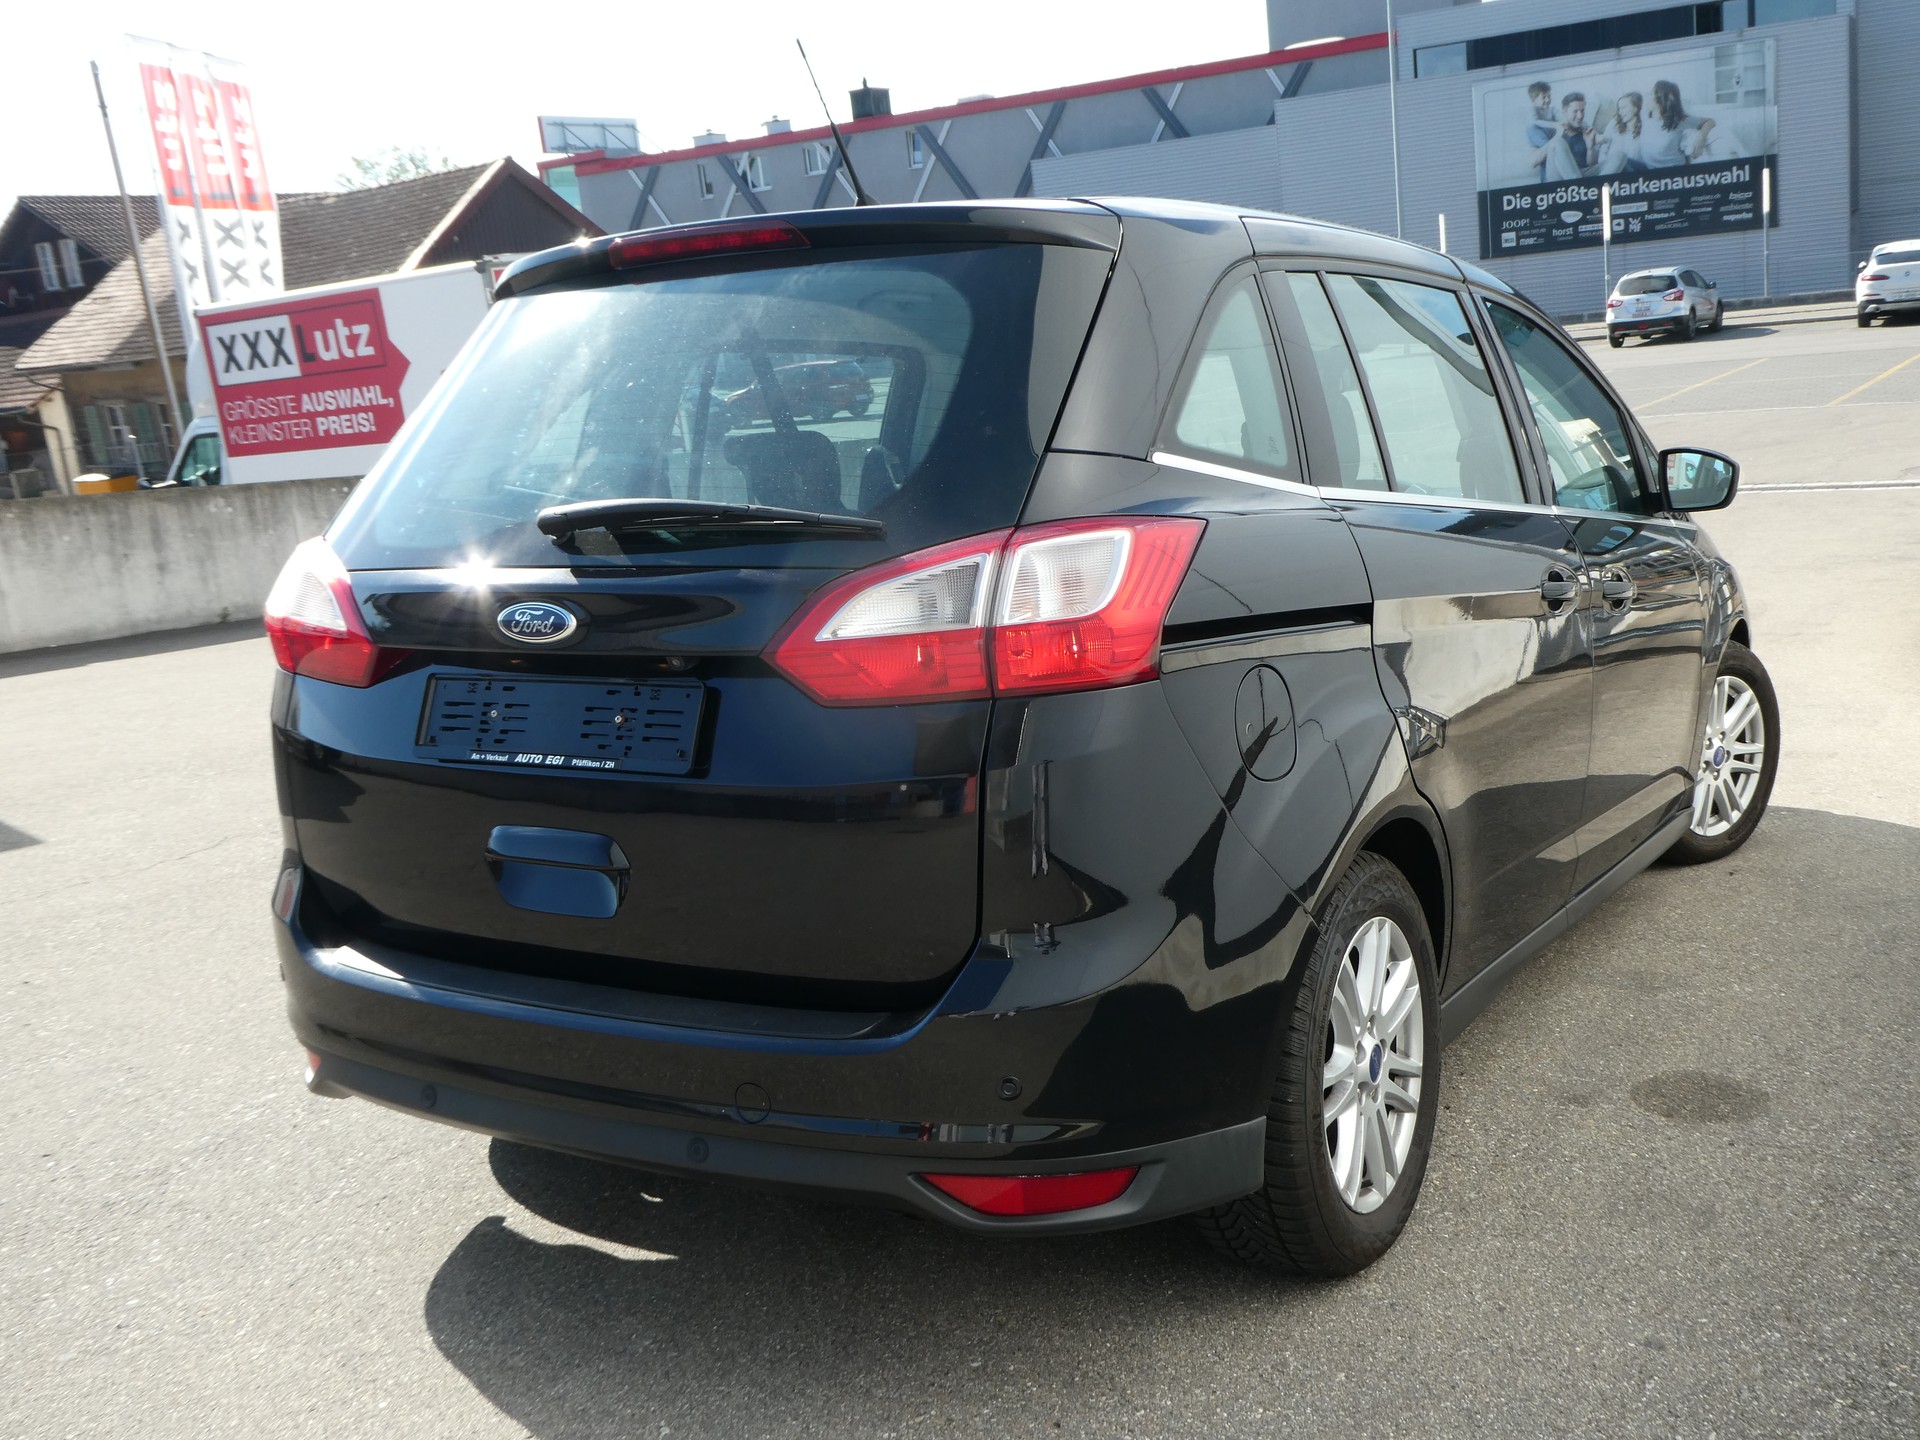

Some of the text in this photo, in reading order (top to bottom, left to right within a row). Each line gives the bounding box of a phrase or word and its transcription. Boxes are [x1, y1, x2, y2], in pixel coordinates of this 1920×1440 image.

[1503, 165, 1750, 211] Die größte Markenauswahl
[1501, 218, 1530, 229] JOOP!
[1552, 227, 1573, 236] horst
[223, 385, 395, 421] GRÖSSTE AUSWAHL,
[227, 412, 377, 445] KLEINSTER PREIS!
[511, 608, 554, 634] Ford
[471, 752, 480, 760] An
[486, 753, 509, 762] Verkauf
[514, 753, 543, 764] AUTO
[545, 755, 565, 765] EGI
[571, 758, 600, 768] Pfäffikon
[605, 760, 615, 769] ZH
